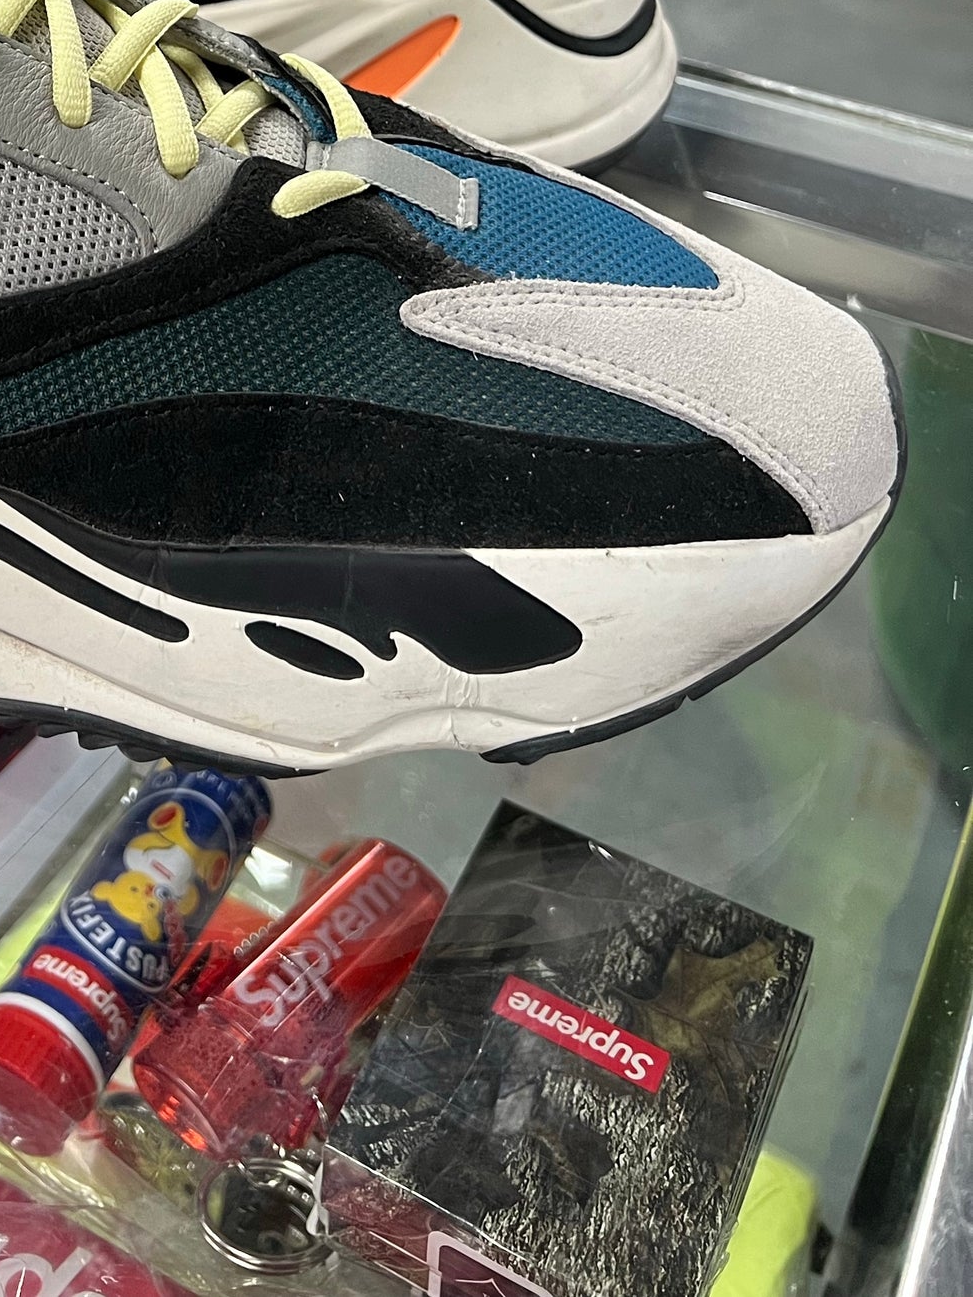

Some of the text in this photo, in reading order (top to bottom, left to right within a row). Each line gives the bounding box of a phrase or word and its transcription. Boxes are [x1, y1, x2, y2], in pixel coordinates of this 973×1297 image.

[234, 854, 420, 1027] Supreme
[32, 953, 127, 1041] Supreme
[507, 991, 655, 1081] Supreme
